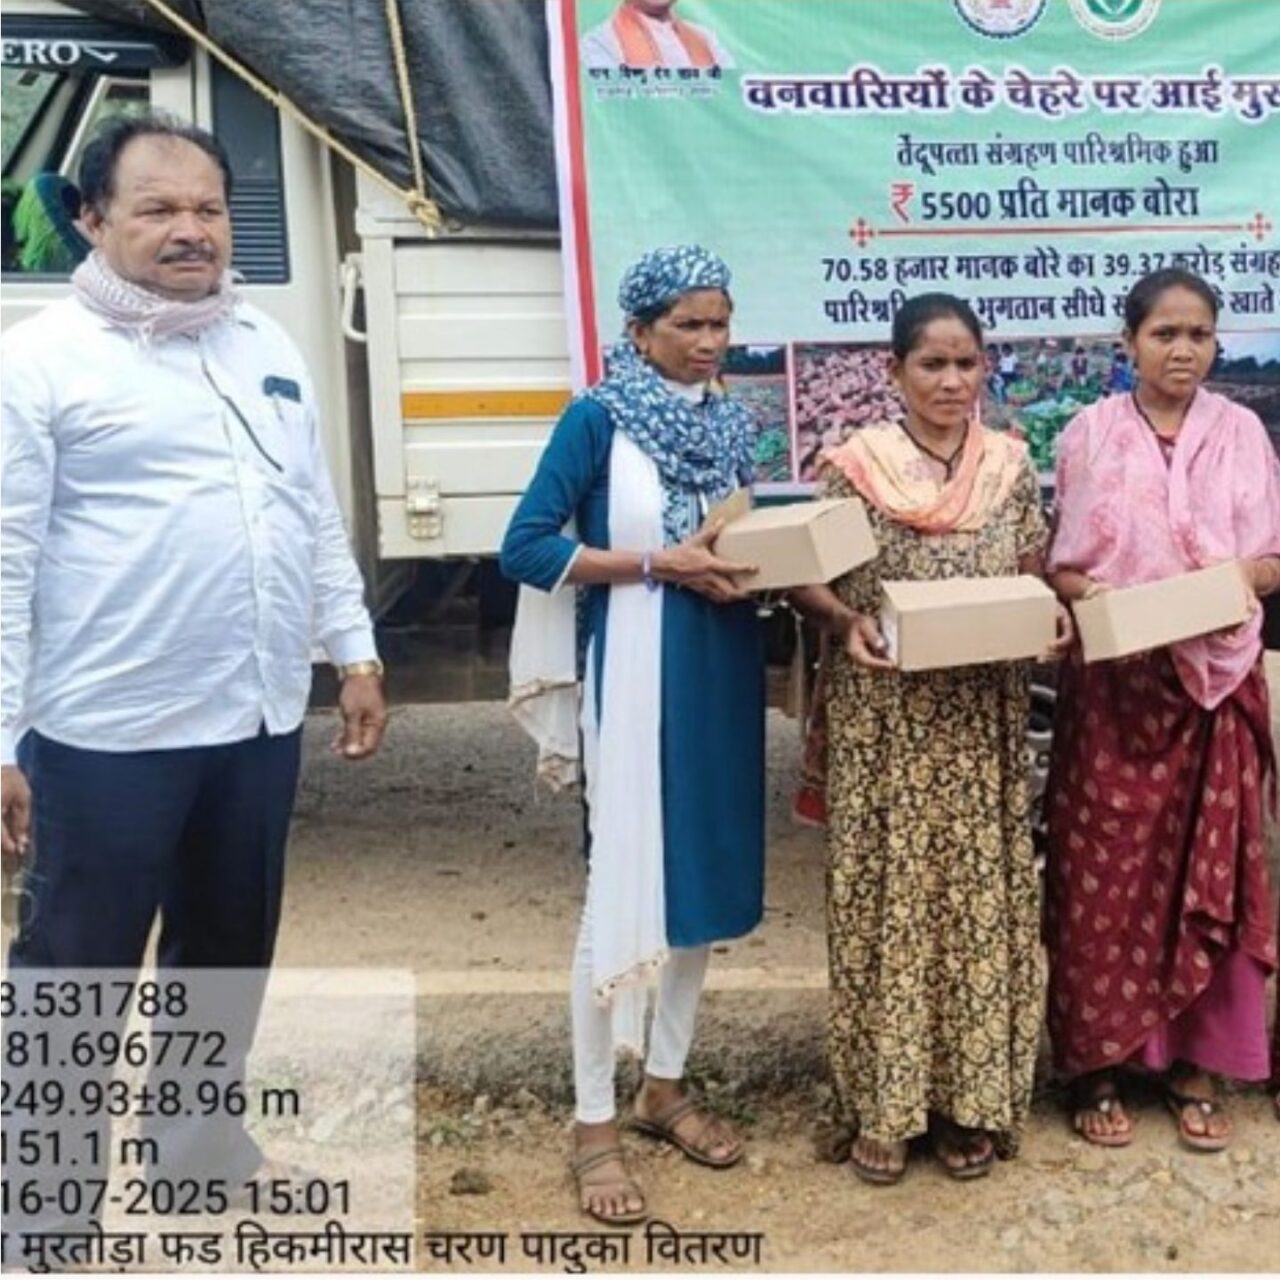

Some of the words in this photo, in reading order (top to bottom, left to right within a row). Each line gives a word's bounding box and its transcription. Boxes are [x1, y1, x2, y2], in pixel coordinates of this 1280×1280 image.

[745, 67, 949, 109] वनवासियों
[960, 69, 994, 109] के
[1005, 69, 1083, 115] चेहरे
[1093, 79, 1142, 108] पर
[1152, 69, 1222, 111] आई
[986, 132, 1056, 170] संग्रहण
[1063, 132, 1171, 166] पारिश्रमिक
[1177, 139, 1219, 172] हुआ
[892, 183, 913, 223] ₹
[921, 192, 991, 220] 5500
[999, 176, 1050, 220] प्रति
[1057, 186, 1136, 218] मानक
[822, 257, 888, 282] 70.58
[894, 255, 950, 286] हजार
[956, 255, 1018, 279] मानक
[1067, 251, 1094, 277] का
[1103, 252, 1165, 276] 39.37
[978, 294, 1055, 328] भुगतान
[1062, 286, 1106, 319] सीधे
[1230, 282, 1274, 314] खाते
